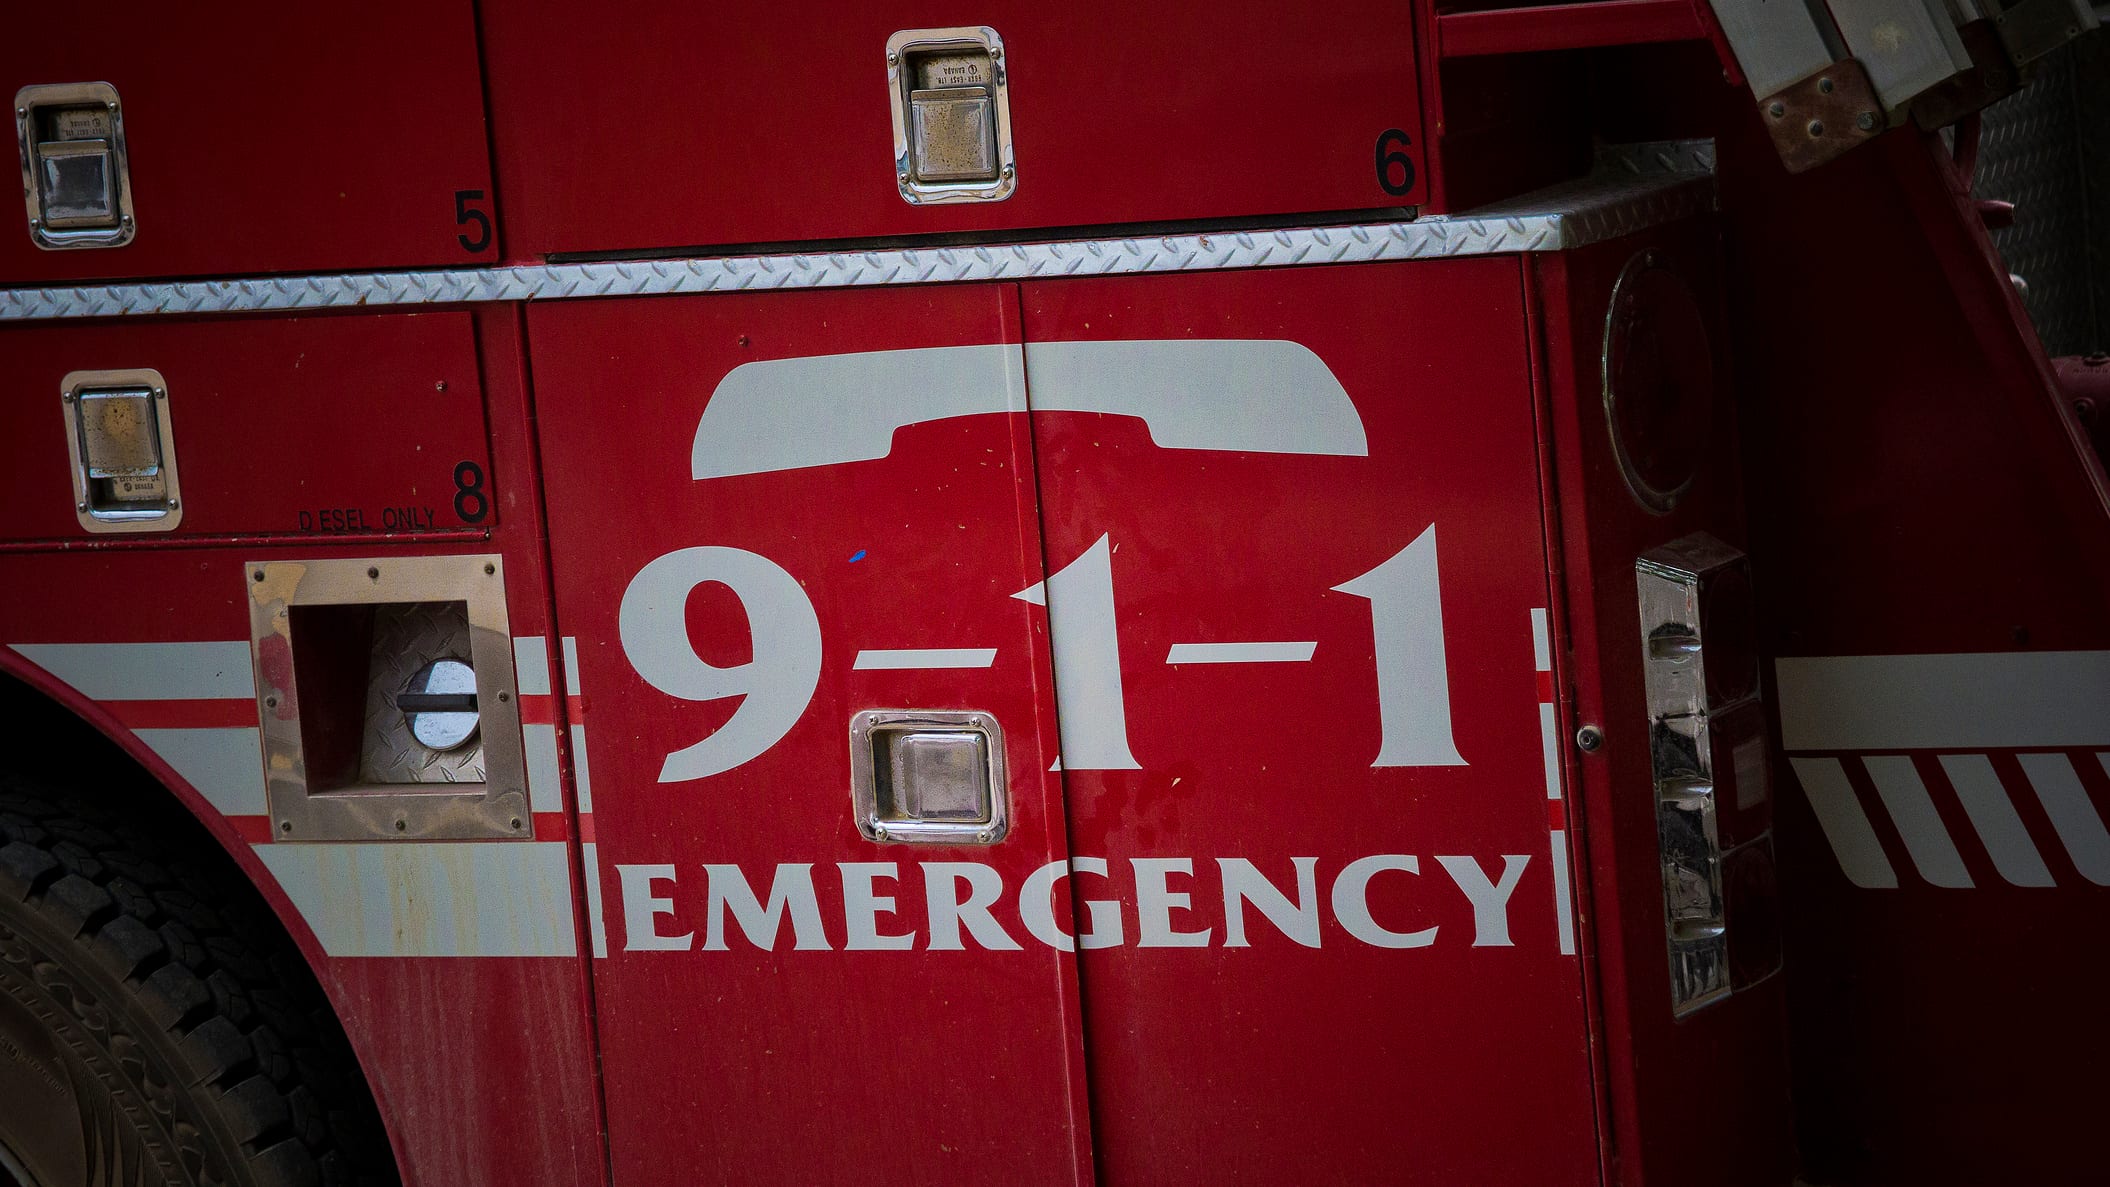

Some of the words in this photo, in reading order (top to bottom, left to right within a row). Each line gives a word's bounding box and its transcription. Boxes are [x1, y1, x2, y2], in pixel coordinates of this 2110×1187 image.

[1375, 128, 1415, 197] 6
[454, 189, 492, 253] 5
[299, 508, 371, 532] DESEL
[383, 506, 435, 530] ONLY
[453, 460, 489, 524] 8
[618, 522, 1470, 783] 9-1-1
[615, 854, 1532, 953] EMERGENCY
